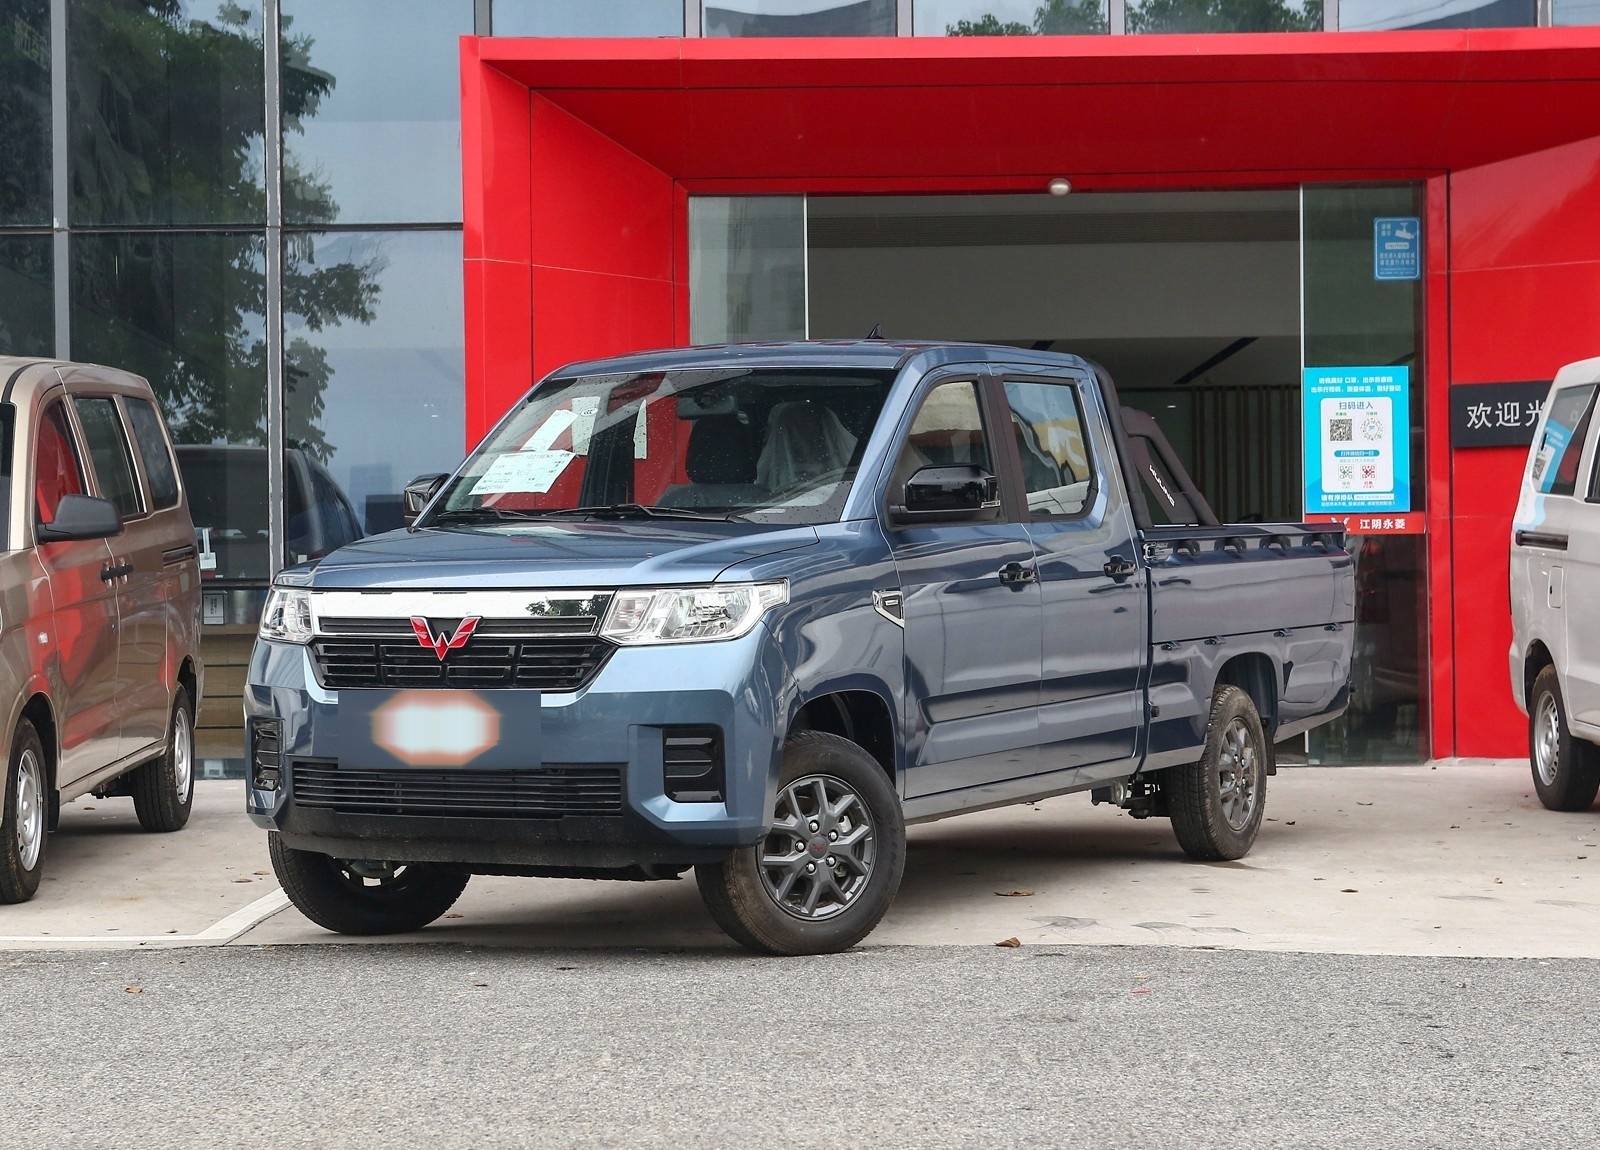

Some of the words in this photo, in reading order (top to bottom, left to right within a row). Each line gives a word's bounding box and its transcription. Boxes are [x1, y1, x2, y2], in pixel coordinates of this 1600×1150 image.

[1338, 401, 1374, 410] 扫码进入
[1360, 518, 1406, 530] 江阴永菱
